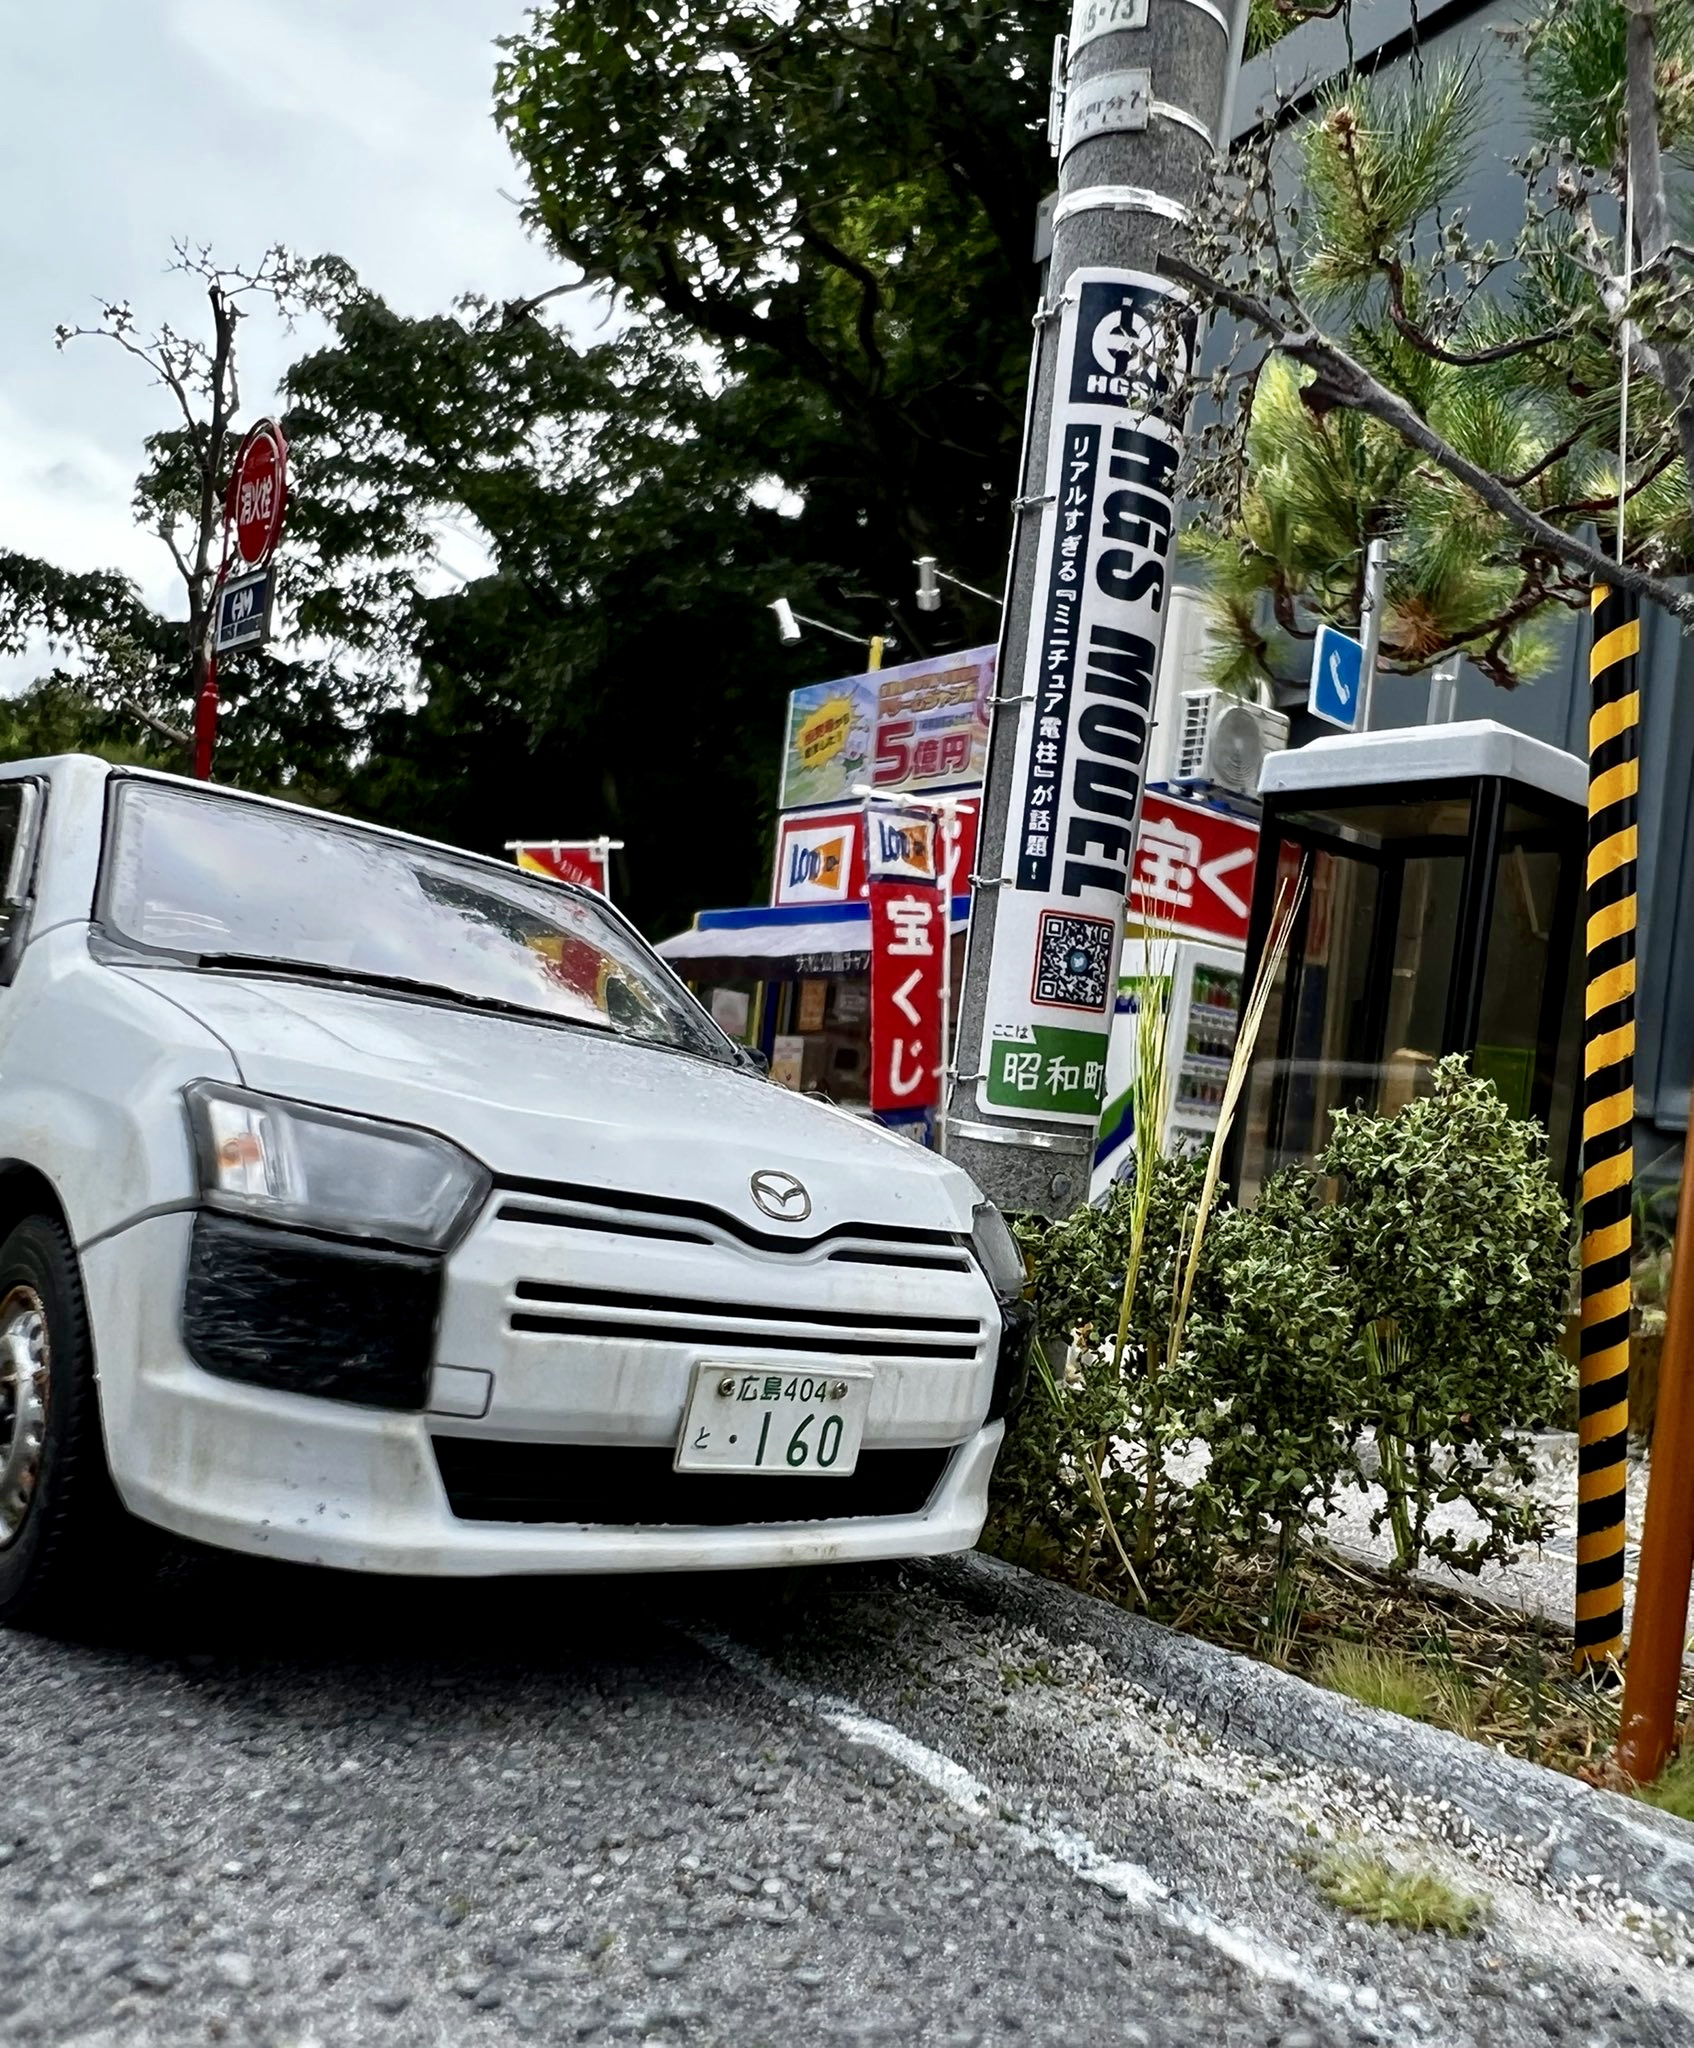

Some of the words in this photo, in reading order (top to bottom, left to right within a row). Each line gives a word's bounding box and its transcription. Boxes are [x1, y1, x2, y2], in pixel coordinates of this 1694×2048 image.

[1087, 374, 1149, 400] HGS
[1096, 427, 1180, 613] HGS
[873, 720, 972, 787] 5億円
[1062, 624, 1156, 898] MODEL
[1131, 818, 1254, 919] 宝く
[887, 894, 934, 1096] 宝くじ
[993, 1024, 1028, 1039] ここは
[1003, 1052, 1104, 1100] 昭和町
